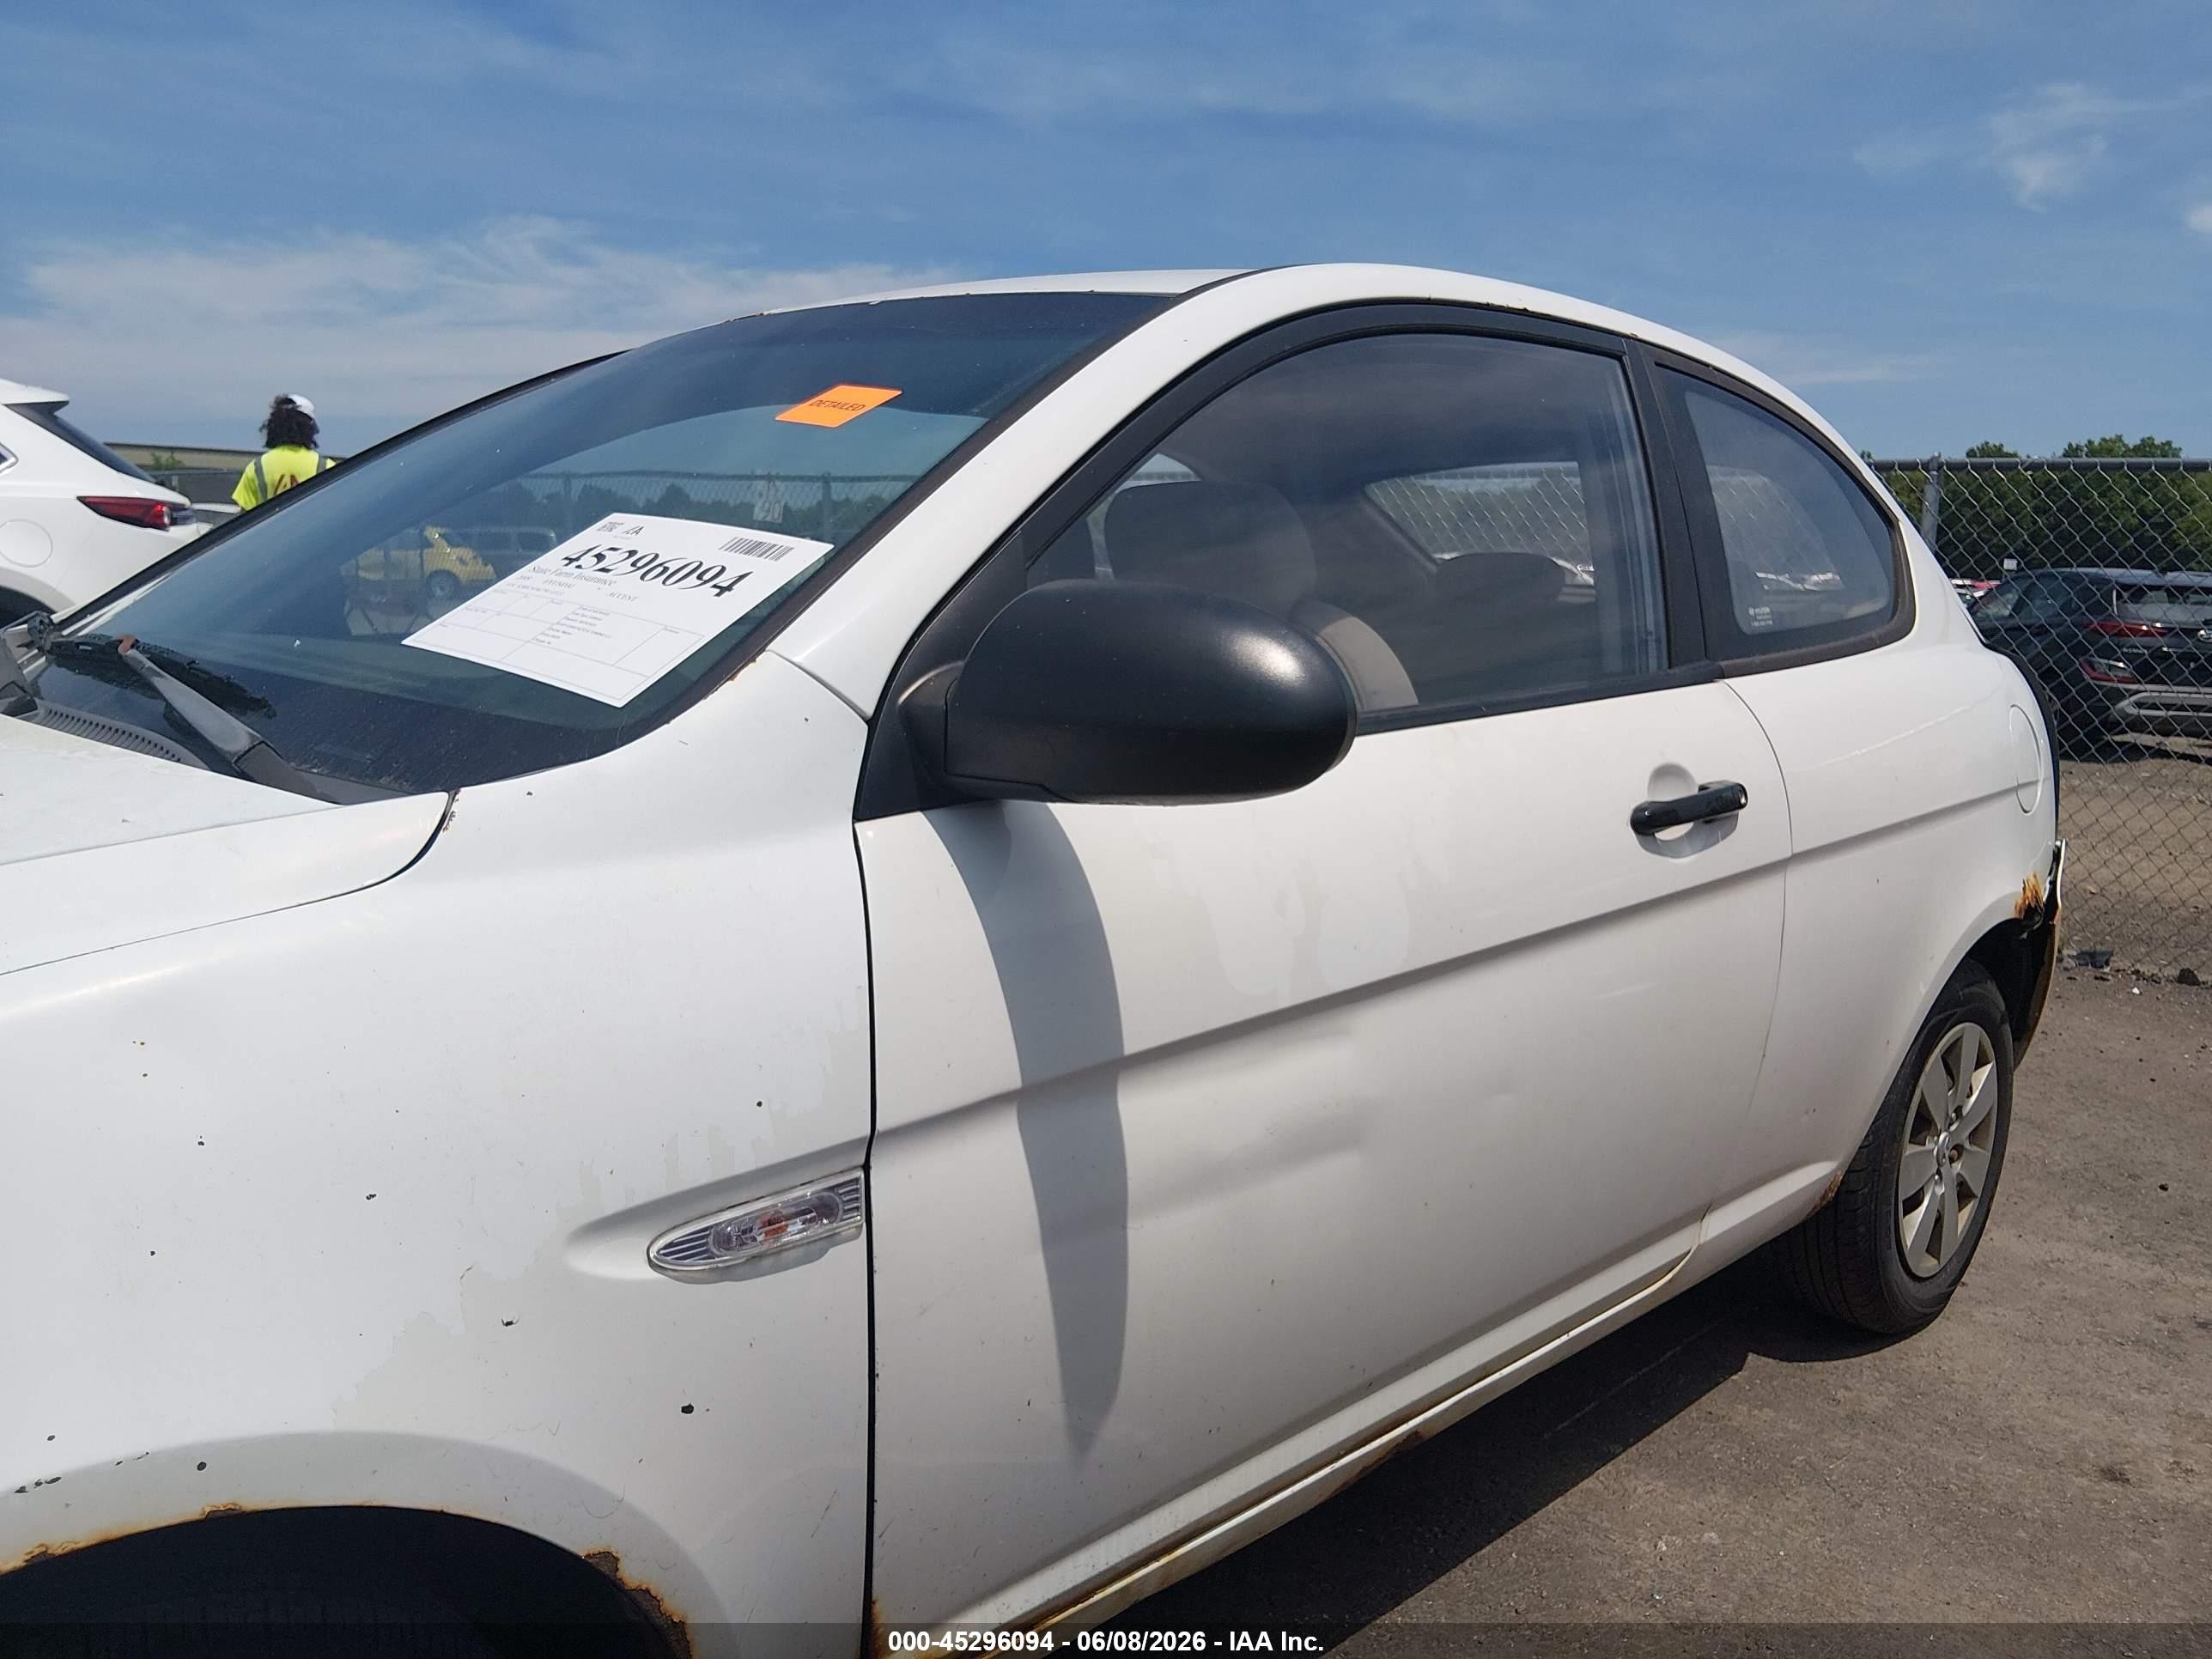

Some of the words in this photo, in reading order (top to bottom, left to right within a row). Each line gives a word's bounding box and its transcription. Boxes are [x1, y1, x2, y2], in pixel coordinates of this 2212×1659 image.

[808, 399, 866, 410] DETAILED
[550, 568, 574, 577] Farm
[573, 572, 617, 586] Insurance
[561, 544, 754, 598] 45296094
